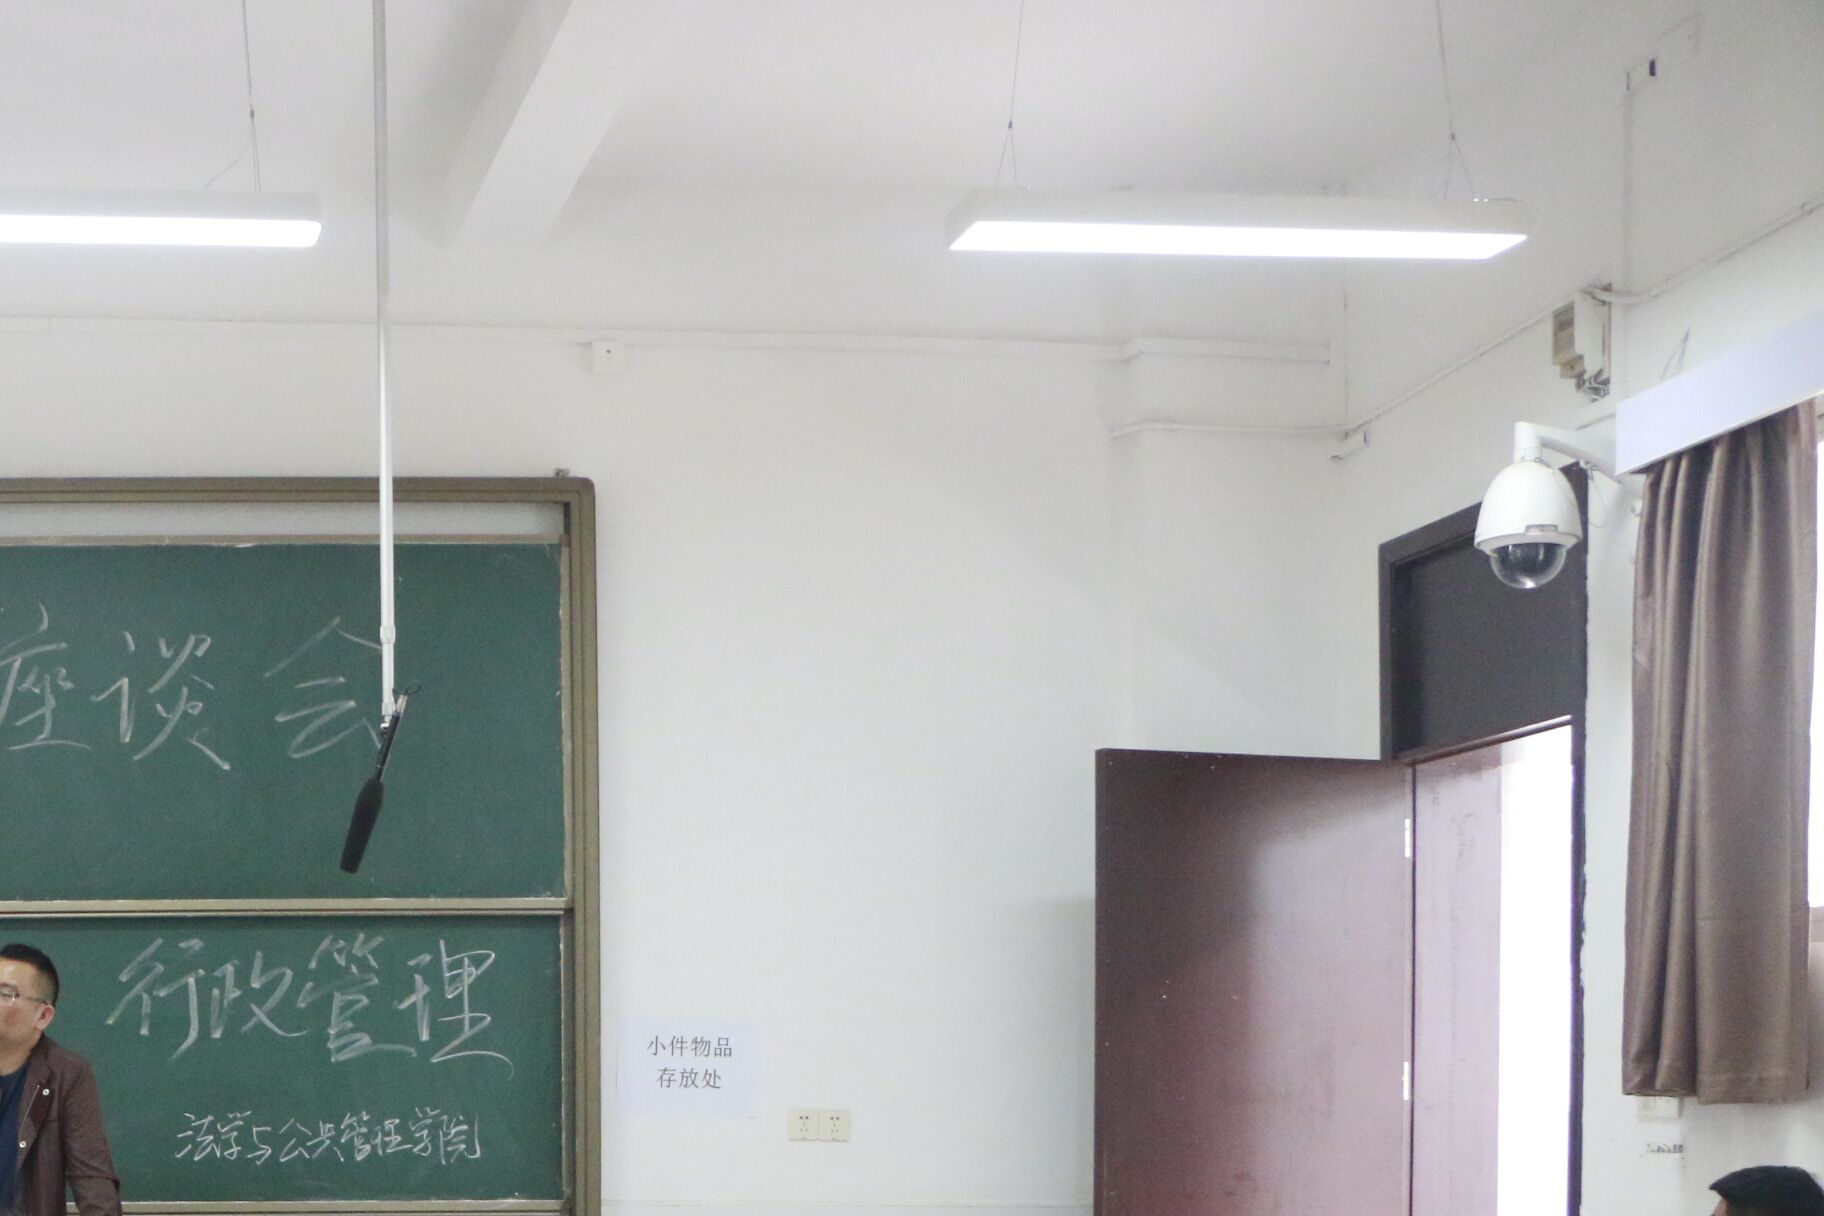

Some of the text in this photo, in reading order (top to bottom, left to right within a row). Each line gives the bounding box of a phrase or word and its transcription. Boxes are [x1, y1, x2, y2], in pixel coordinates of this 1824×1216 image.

[105, 931, 515, 1081] 行政管理
[646, 1034, 733, 1058] 小件物品
[656, 1066, 723, 1090] 存放处
[175, 1106, 481, 1165] 法学与公共管理学院
